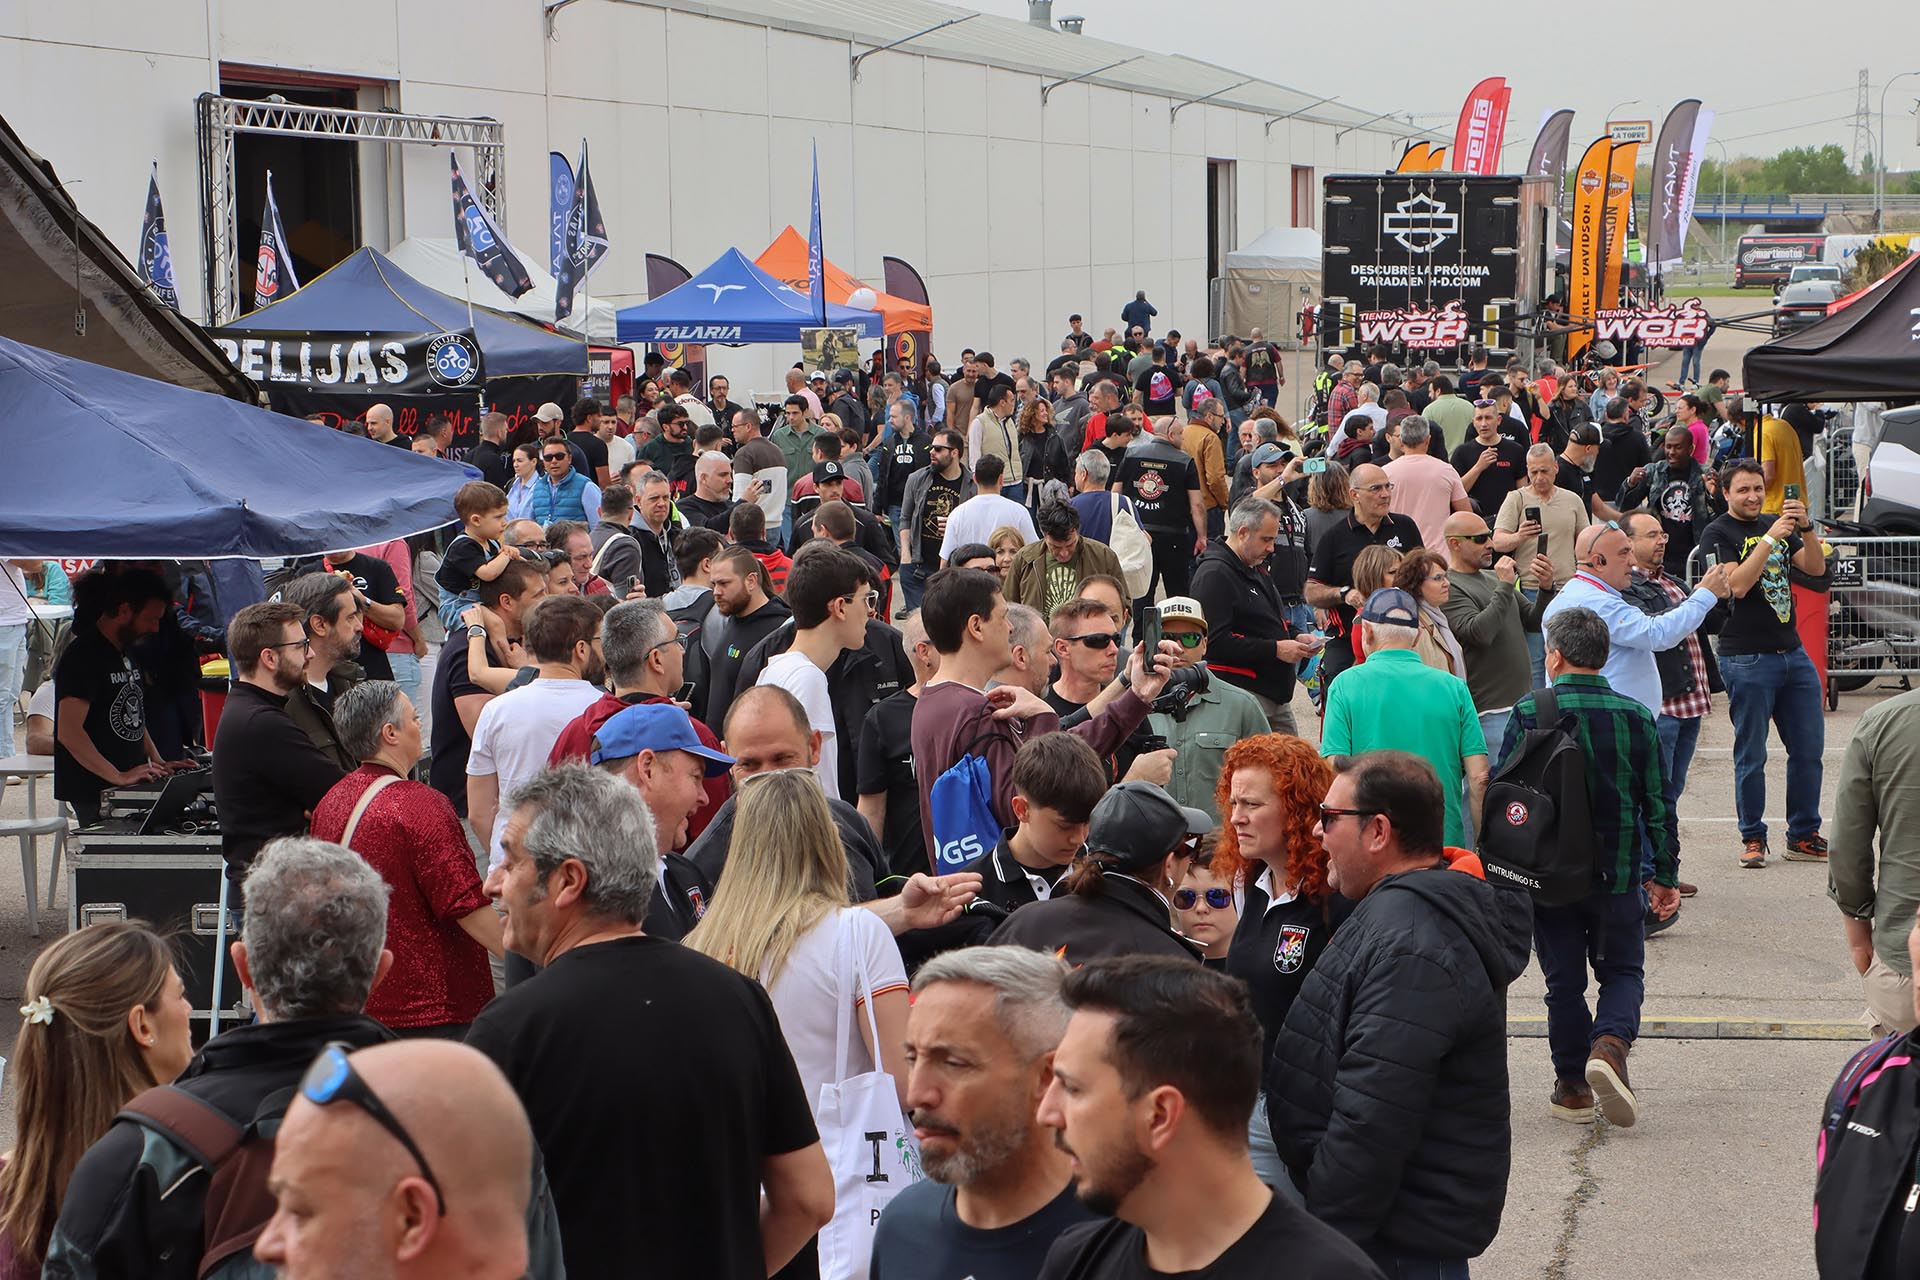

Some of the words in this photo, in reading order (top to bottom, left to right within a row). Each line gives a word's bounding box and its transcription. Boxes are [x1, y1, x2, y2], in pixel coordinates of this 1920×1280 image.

[1663, 144, 1680, 219] Y-AMT
[1351, 264, 1415, 275] DESCUBRE
[1418, 265, 1431, 275] LA
[1434, 263, 1490, 276] PRÓXIMA
[1359, 276, 1408, 286] PARADA
[1410, 277, 1424, 286] EN
[1429, 277, 1481, 287] H-D.COM
[1360, 312, 1398, 320] TIENDA
[1596, 310, 1635, 318] TIENDA
[654, 326, 742, 339] TALARIA
[431, 335, 461, 352] PELIJAS
[1645, 338, 1695, 346] RACING
[428, 352, 436, 369] LOS
[457, 367, 476, 385] PARLA
[1134, 499, 1161, 510] SPAIN
[1163, 604, 1193, 614] DEUS
[1487, 863, 1529, 886] CINTRUÉNIGO
[1529, 879, 1542, 889] F.S.
[864, 1131, 889, 1182] I
